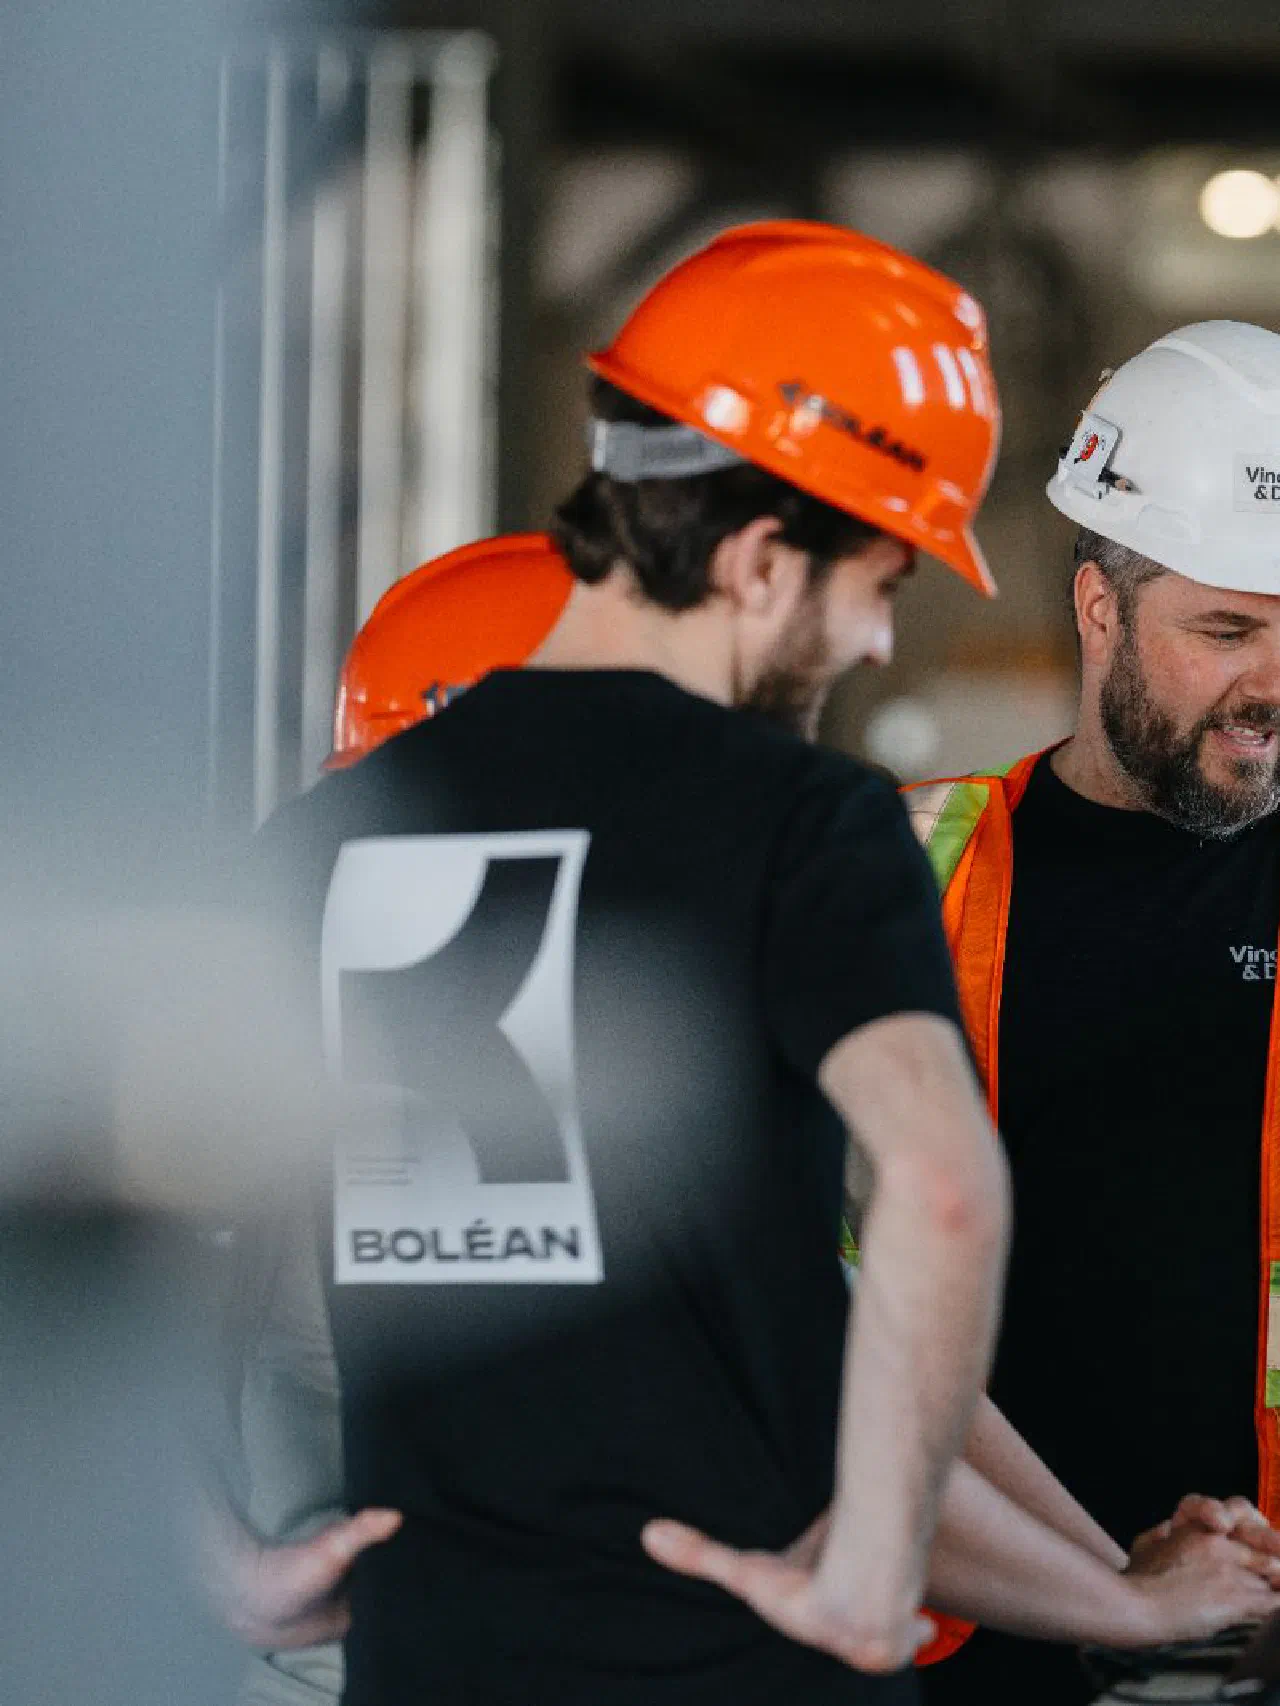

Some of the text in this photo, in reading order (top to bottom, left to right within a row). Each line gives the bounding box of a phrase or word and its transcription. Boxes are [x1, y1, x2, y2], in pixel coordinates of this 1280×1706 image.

[1253, 484, 1268, 500] &
[1242, 964, 1261, 980] &
[349, 1217, 582, 1264] BOLÉAN
